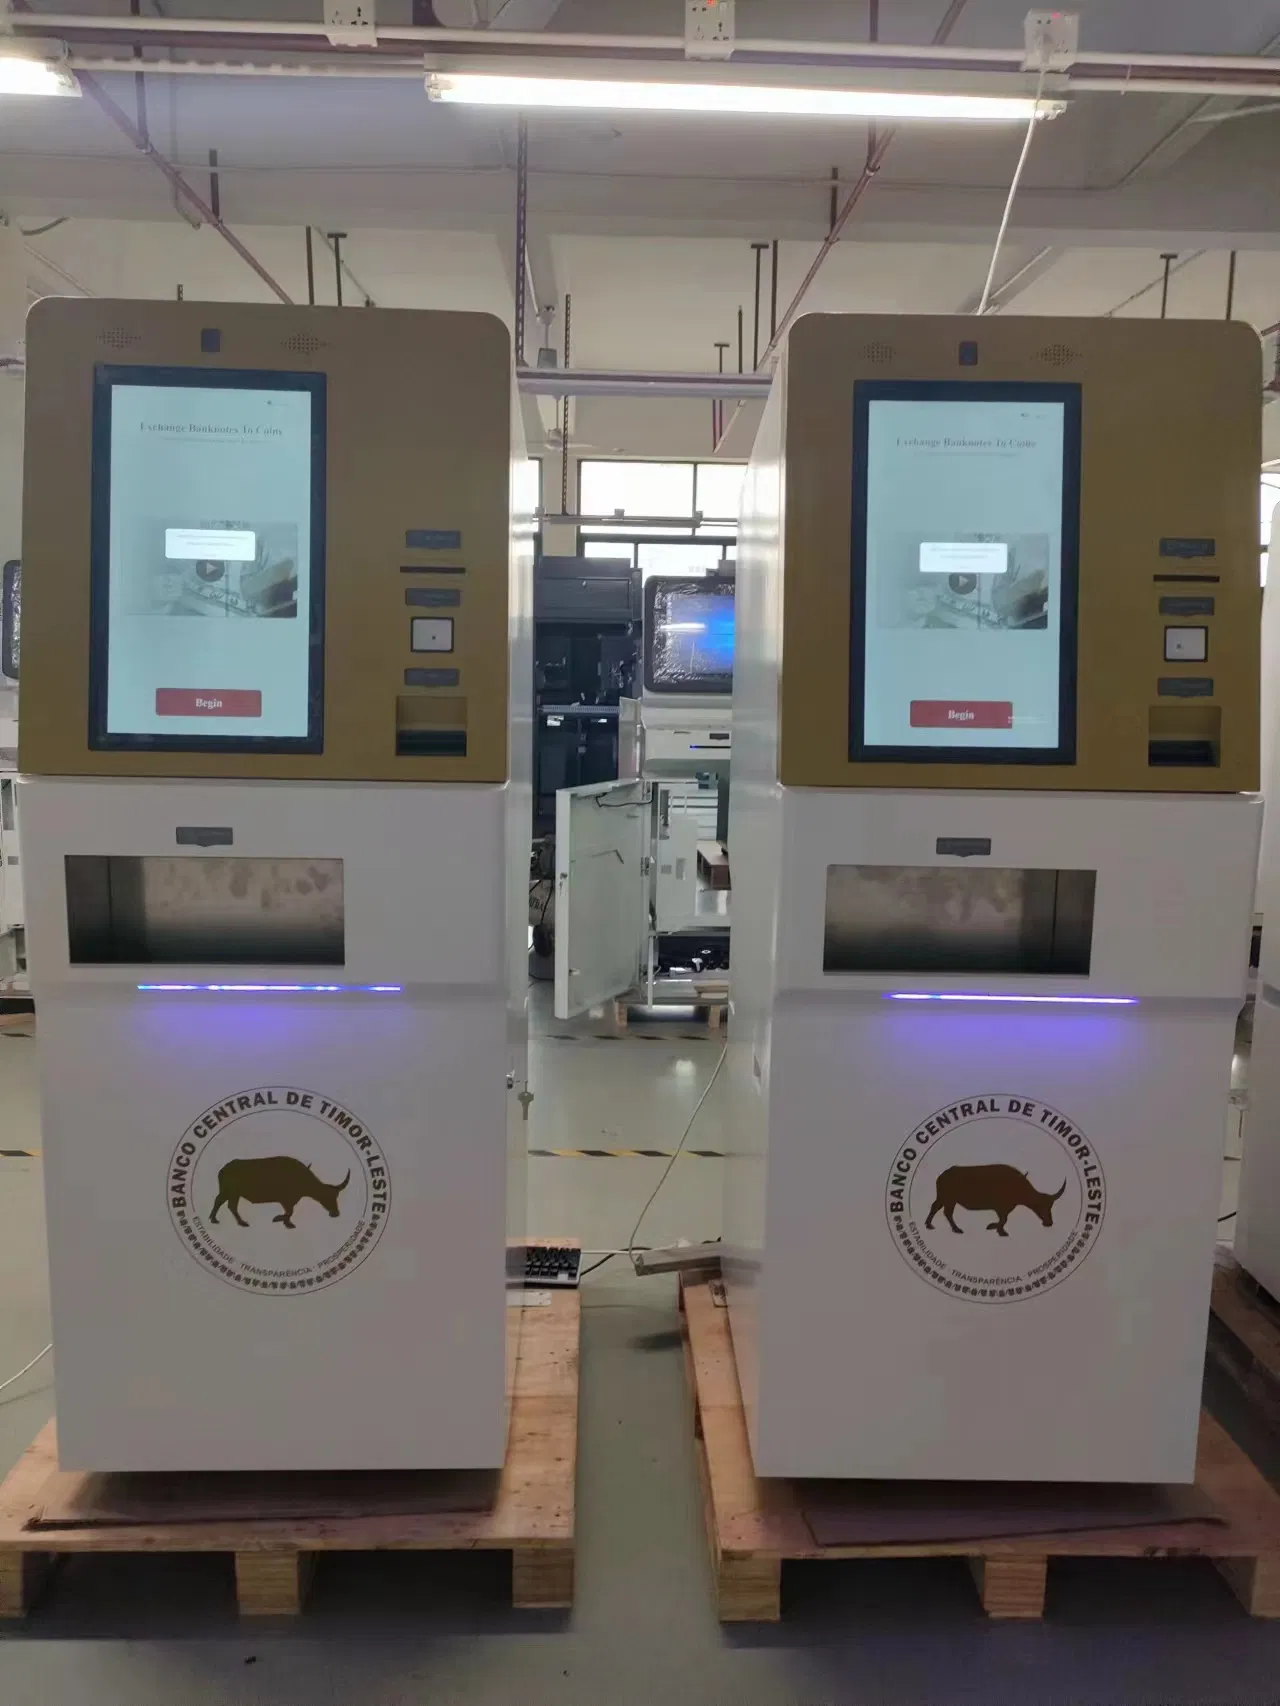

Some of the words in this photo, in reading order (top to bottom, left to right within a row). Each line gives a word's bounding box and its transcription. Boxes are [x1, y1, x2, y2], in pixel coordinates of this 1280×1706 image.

[195, 697, 223, 710] Begin
[948, 709, 975, 721] Begin
[171, 1141, 196, 1209] BANCO
[193, 1091, 279, 1139] CENTRAL
[285, 1091, 314, 1109] DE
[319, 1100, 388, 1214] TIMOR-LESTE
[890, 1147, 917, 1214] BANCO
[915, 1098, 1001, 1145] CENTRAL
[1007, 1099, 1036, 1117] DE
[1039, 1109, 1102, 1225] TIMOR-LESTE
[908, 1220, 947, 1269] ESTABILIDADE
